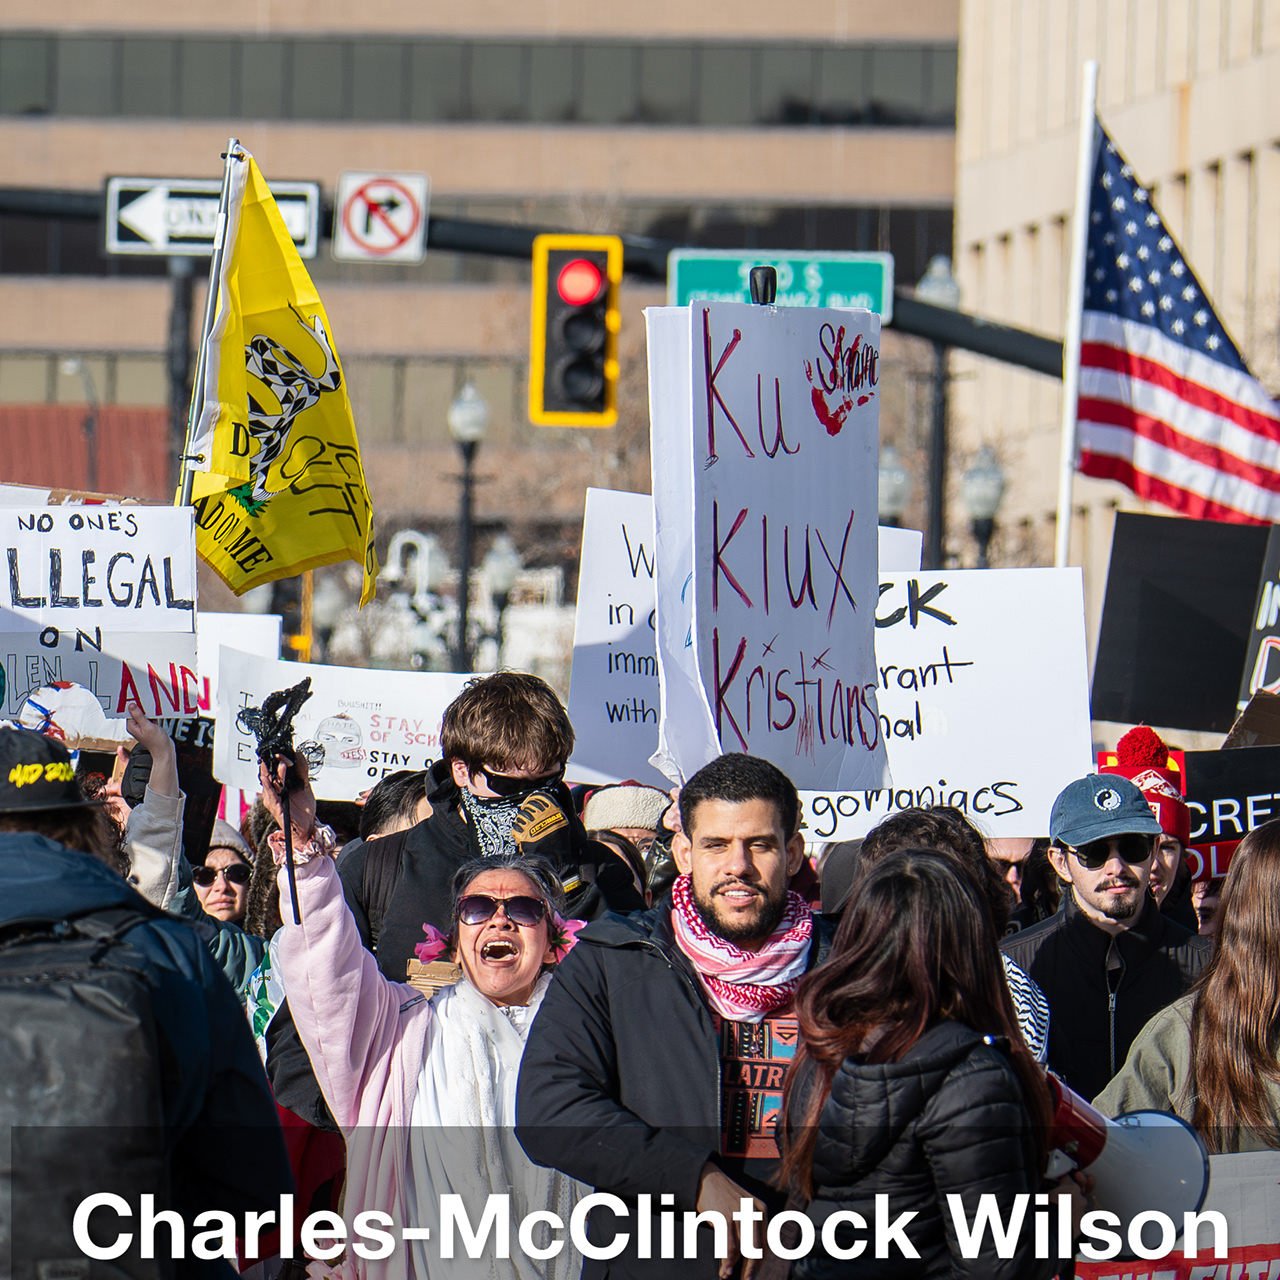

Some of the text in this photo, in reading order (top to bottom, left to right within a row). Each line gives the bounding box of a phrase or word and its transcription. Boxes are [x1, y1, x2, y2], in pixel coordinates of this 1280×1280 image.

[18, 511, 138, 538] NO ONE'S
[224, 525, 275, 575] ME
[608, 592, 635, 626] in
[40, 625, 103, 654] ON
[370, 713, 424, 733] STAY
[606, 698, 658, 725] with
[369, 750, 412, 767] STAY
